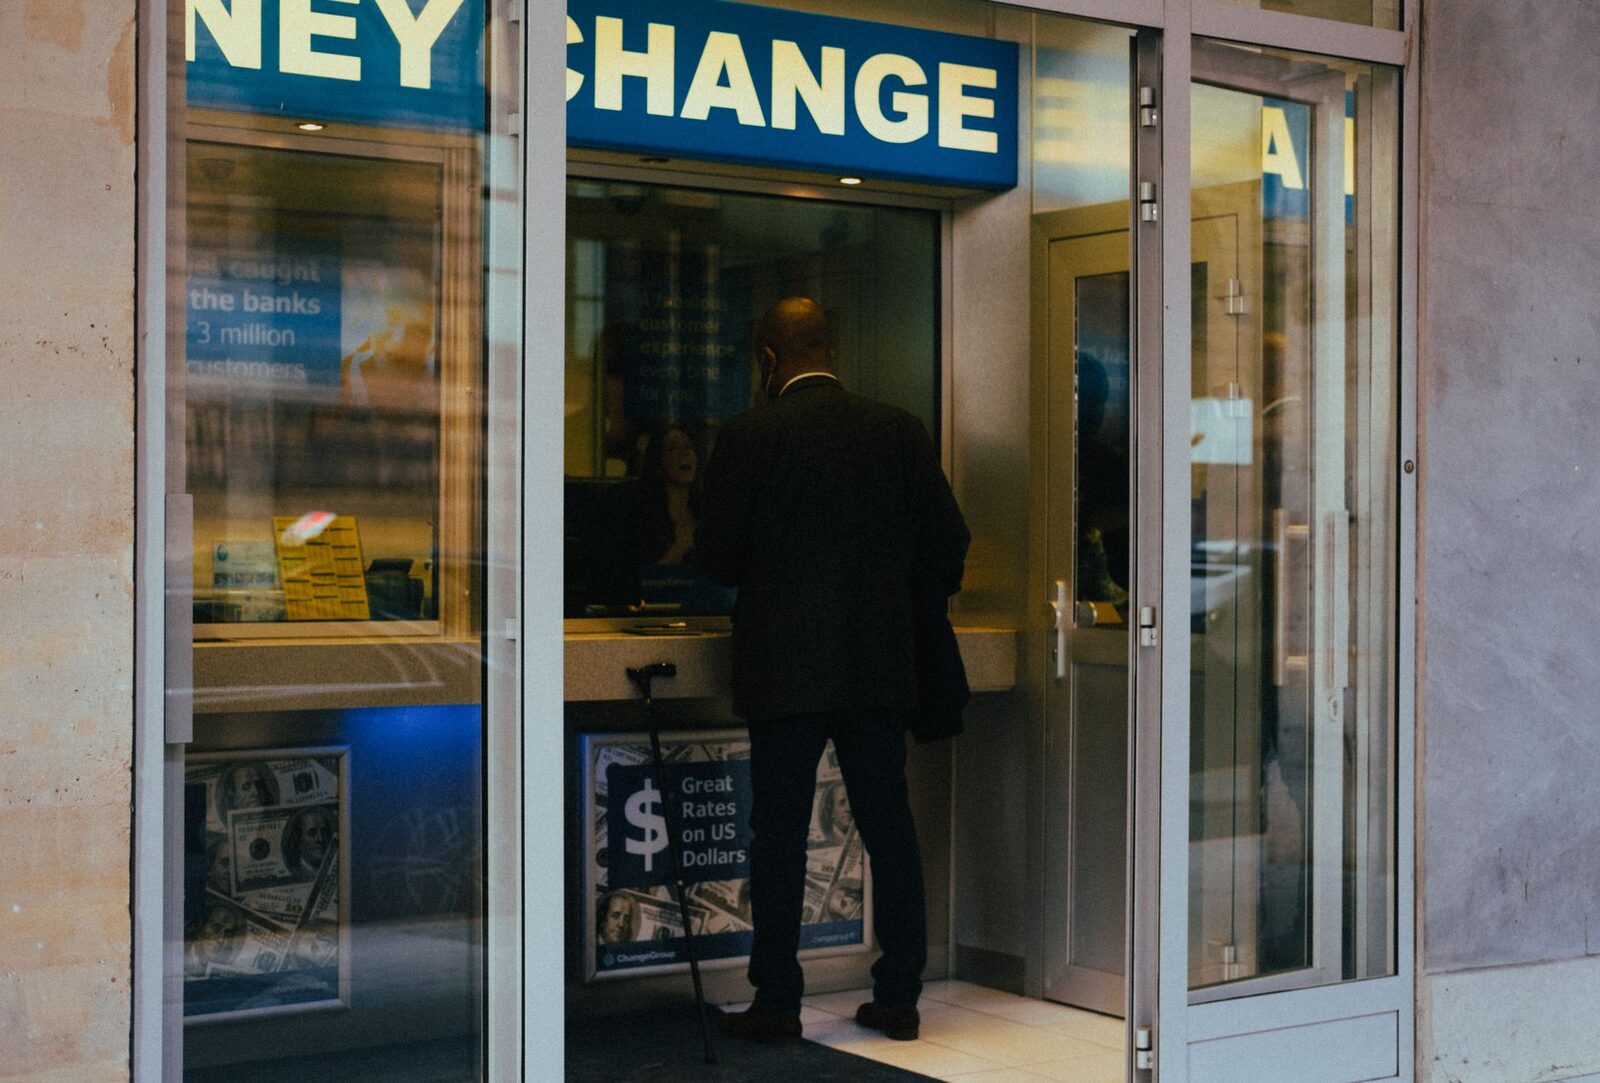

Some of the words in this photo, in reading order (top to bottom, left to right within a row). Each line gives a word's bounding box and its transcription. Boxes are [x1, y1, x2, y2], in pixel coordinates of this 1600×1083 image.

[566, 14, 998, 154] HANGE
[229, 260, 320, 286] caught
[190, 288, 235, 312] the
[243, 289, 321, 316] banks
[197, 322, 211, 345] 3
[220, 323, 296, 347] million
[187, 358, 306, 379] customers
[682, 775, 734, 794] Great
[683, 801, 737, 819] Rates
[682, 828, 705, 843] on
[711, 823, 736, 841] US
[683, 848, 747, 868] Dollars
